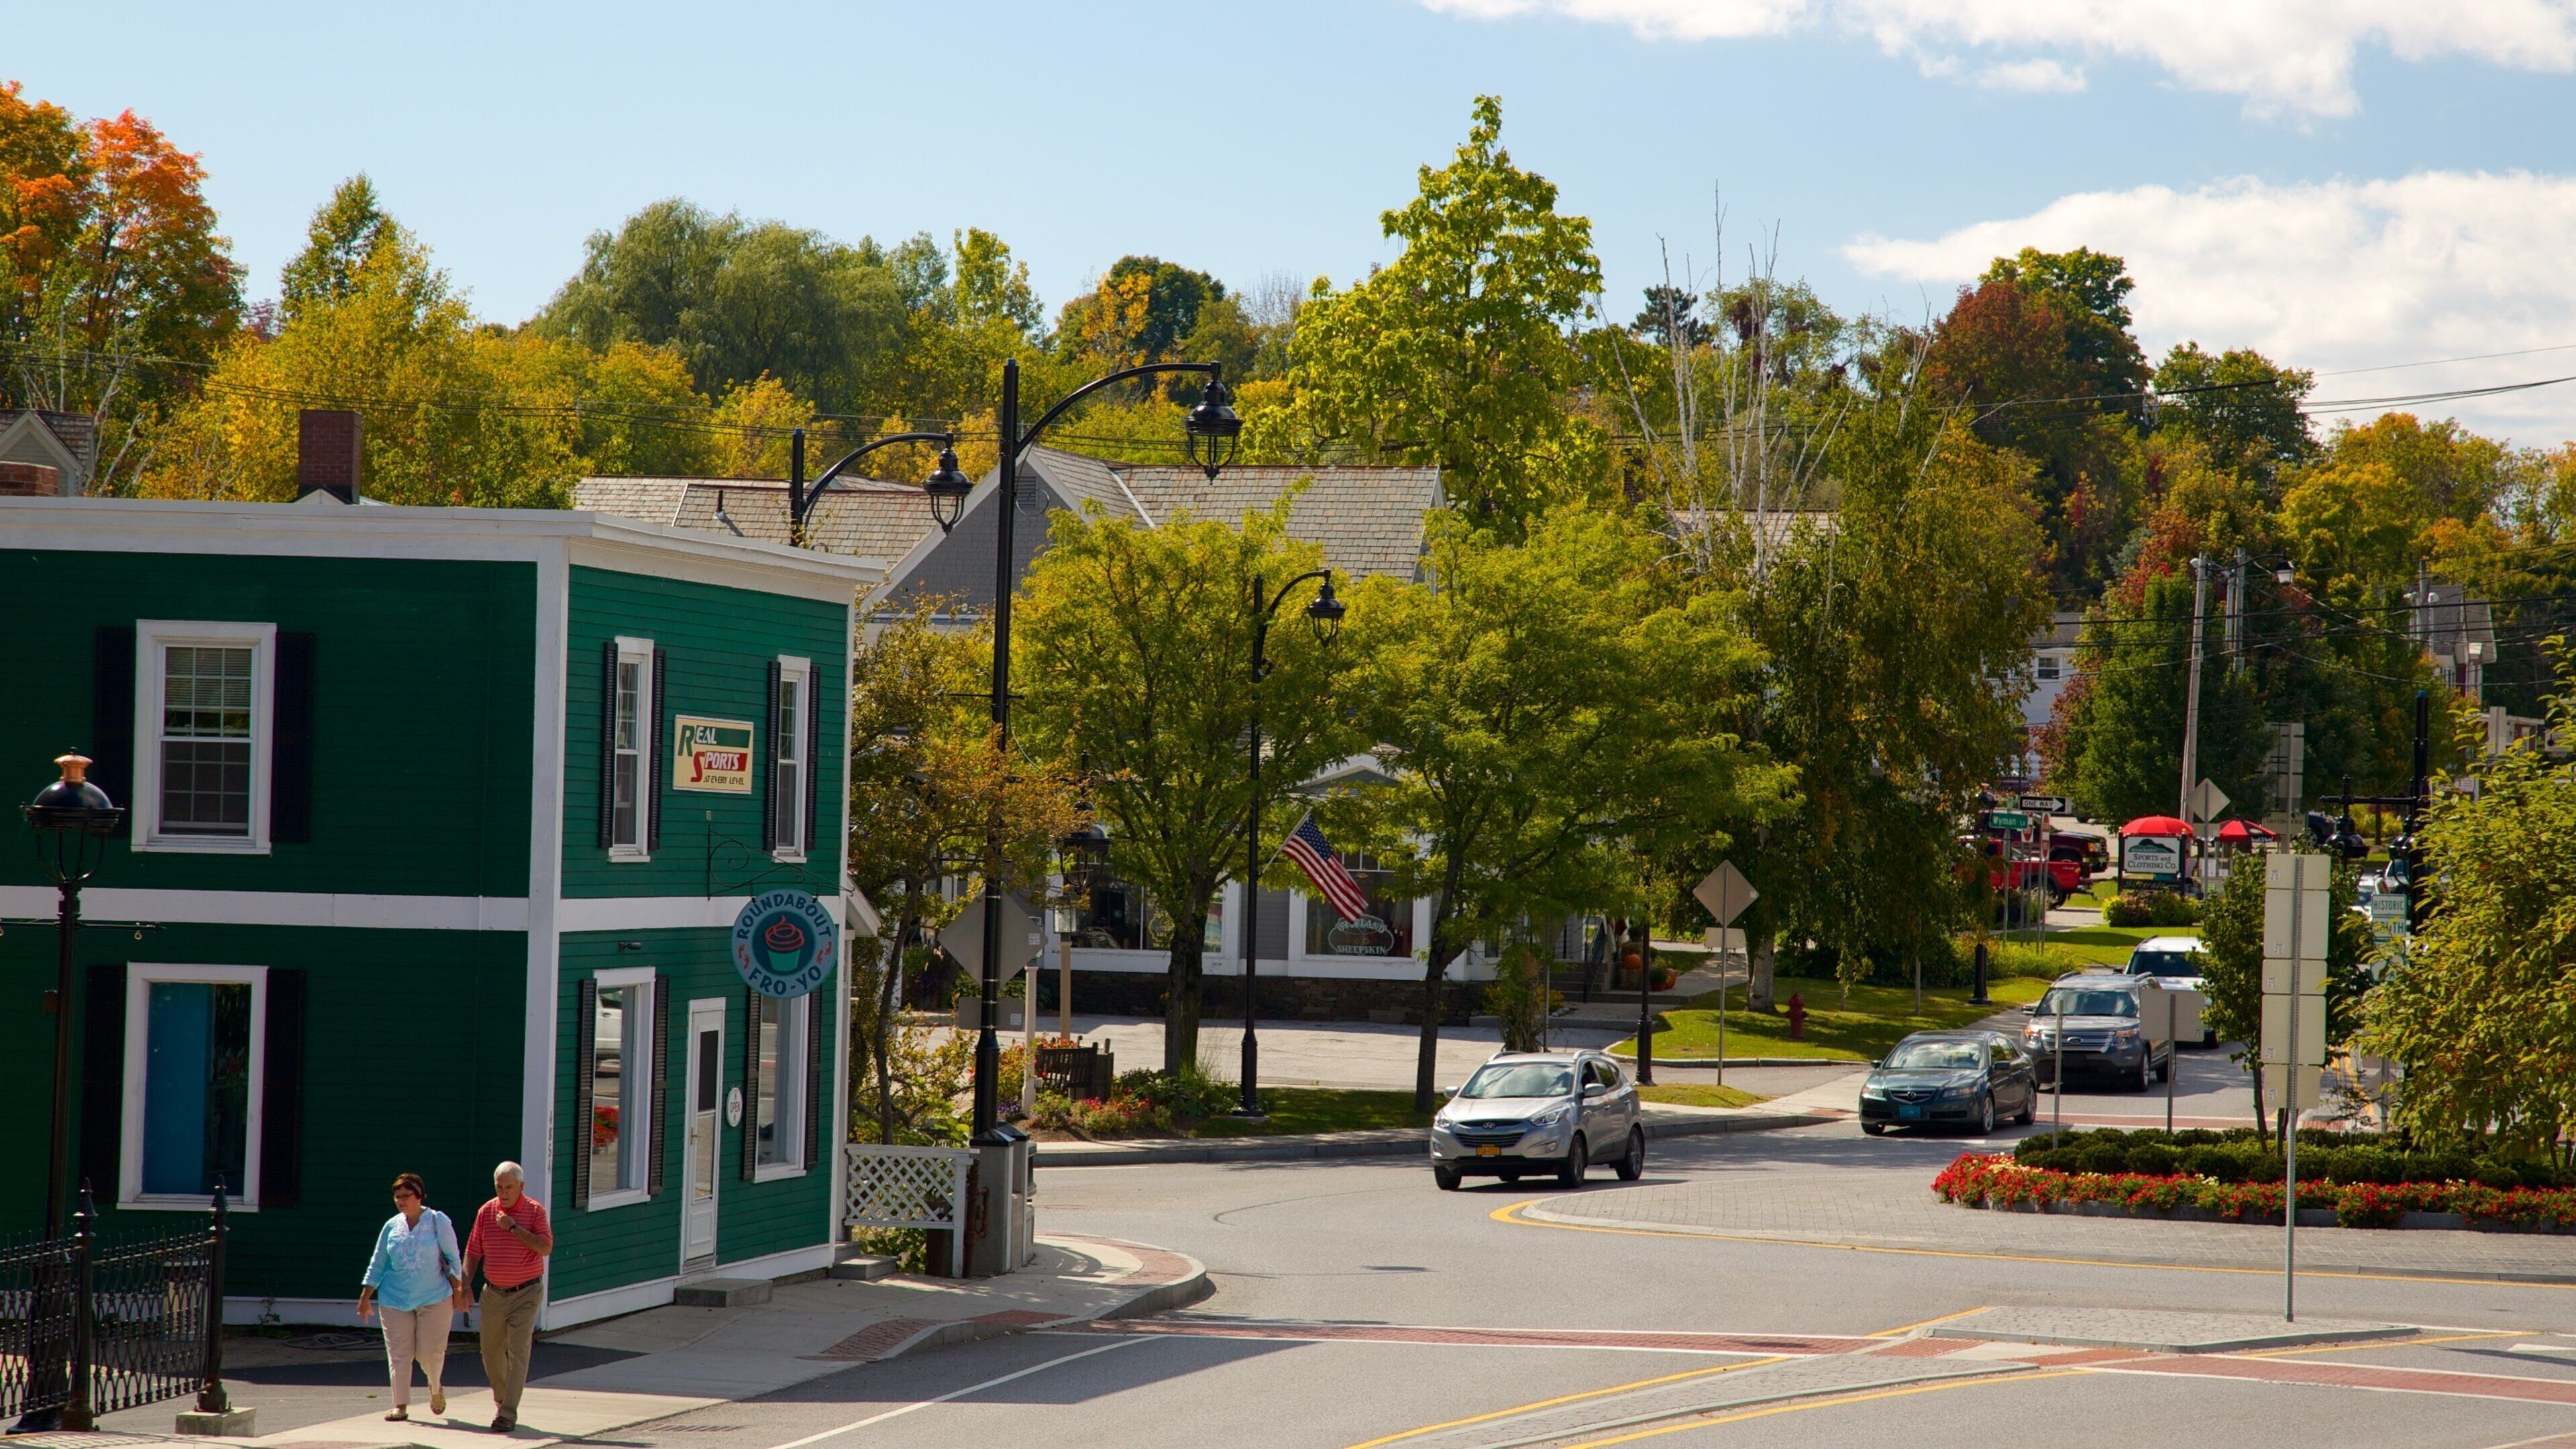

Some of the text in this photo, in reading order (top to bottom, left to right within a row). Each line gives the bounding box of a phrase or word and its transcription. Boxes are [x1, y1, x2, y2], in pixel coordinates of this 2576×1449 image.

[678, 725, 717, 757] REAL
[690, 751, 740, 782] SPORTS
[703, 775, 745, 785] AT EVERY LEVEL
[1993, 816, 2017, 826] Wyman
[2133, 853, 2159, 861] SPORTS
[2127, 860, 2163, 869] CLOTHING
[2373, 900, 2404, 911] HISTORIC
[737, 894, 832, 940] ROUNDABOUT
[2373, 921, 2404, 934] UTH
[1337, 945, 1387, 954] SHEEPSKIN
[748, 965, 822, 996] FRO-YO
[729, 1101, 741, 1114] OPEN
